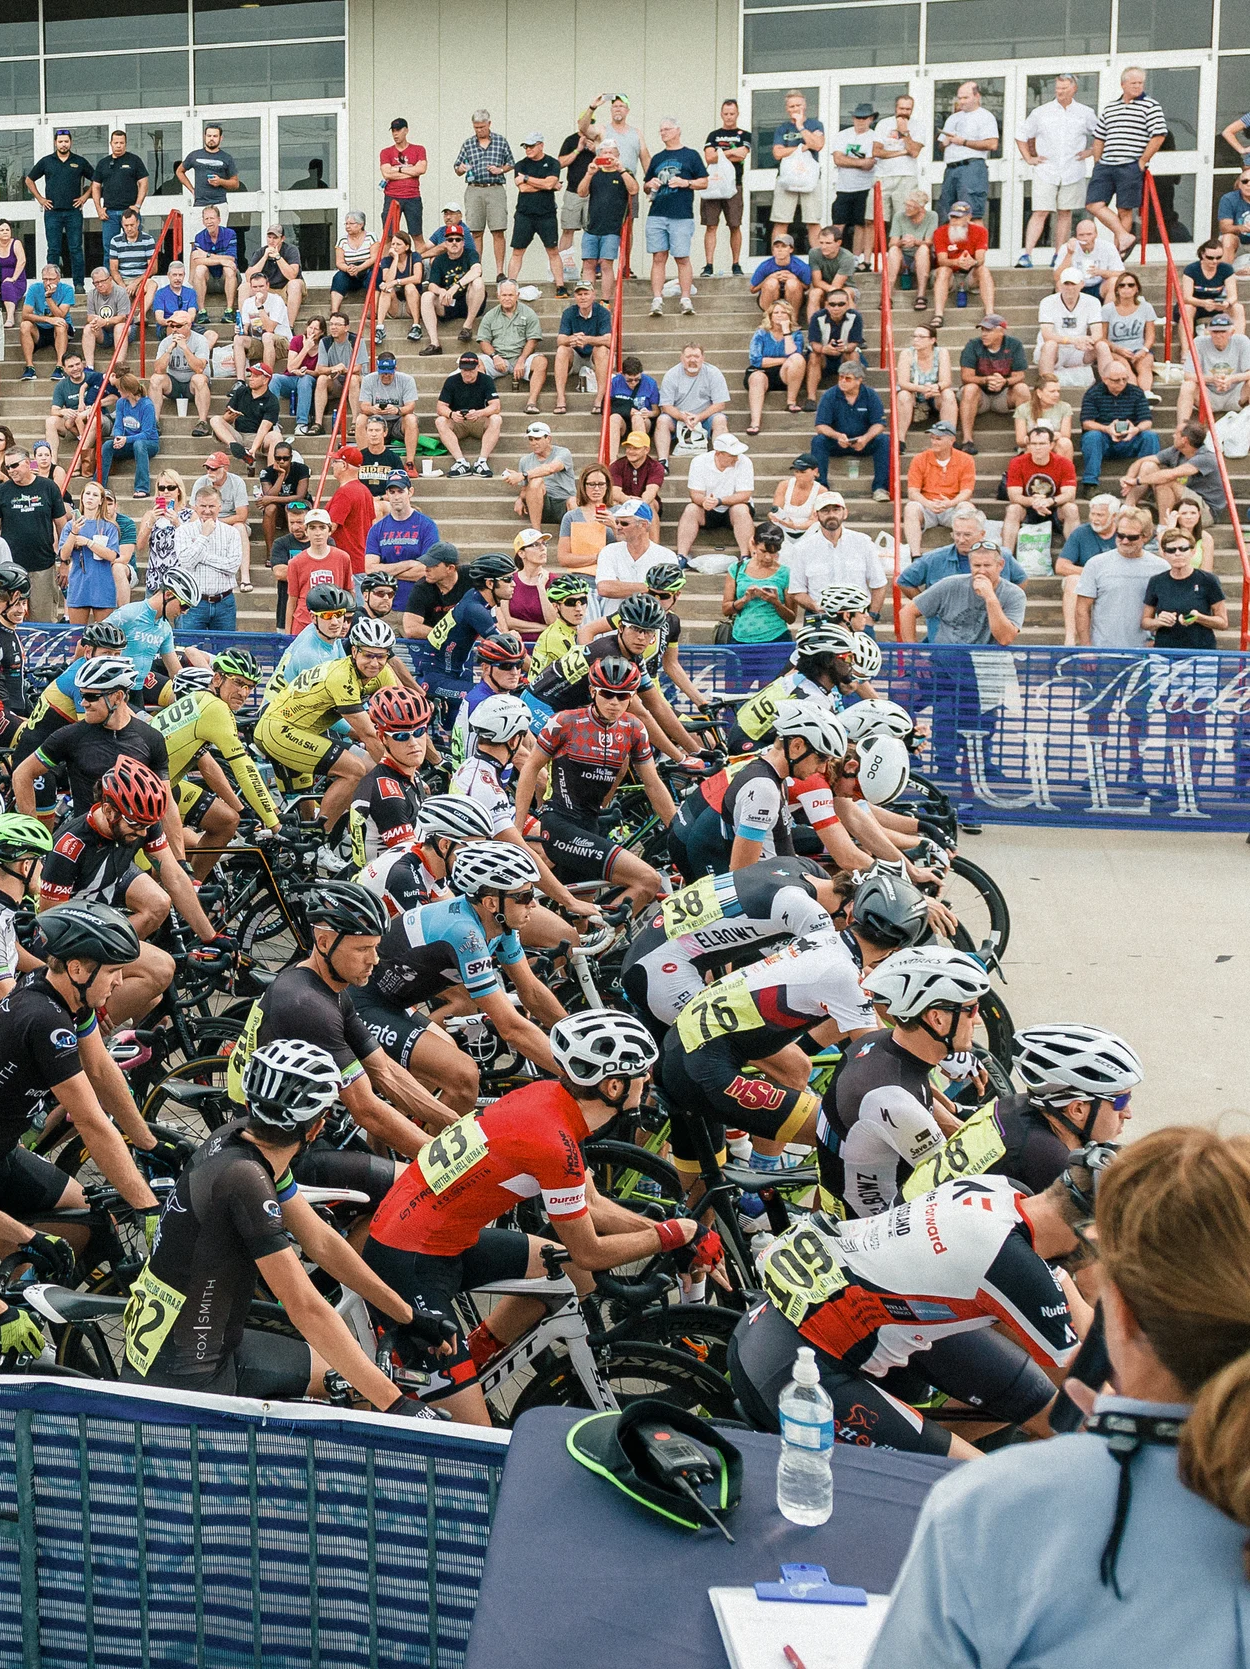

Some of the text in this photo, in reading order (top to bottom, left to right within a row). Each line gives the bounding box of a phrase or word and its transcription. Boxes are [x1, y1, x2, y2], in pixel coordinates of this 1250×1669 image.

[310, 576, 334, 588] USA
[432, 617, 449, 640] 89
[564, 650, 584, 677] 12
[158, 698, 194, 732] 109
[751, 695, 776, 725] 16
[250, 772, 273, 813] CYCLING TEAM
[552, 839, 604, 861] JOHNNY'S
[60, 908, 108, 926] S-WORKS
[664, 890, 704, 925] 38
[694, 925, 764, 949] ELBOWZ
[692, 996, 739, 1040] 76
[1094, 1058, 1124, 1076] SCOTT
[724, 1076, 786, 1110] MSU
[428, 1125, 468, 1170] 43
[910, 1145, 928, 1156] Save
[980, 1150, 998, 1167] RACES
[432, 1173, 450, 1190] HOTTER
[454, 1160, 466, 1174] HELL
[466, 1150, 480, 1168] ULTRA
[762, 1230, 834, 1314] 109
[196, 1280, 216, 1360] COX SMITH
[886, 1304, 908, 1312] WELLS
[481, 1337, 538, 1394] OTT
